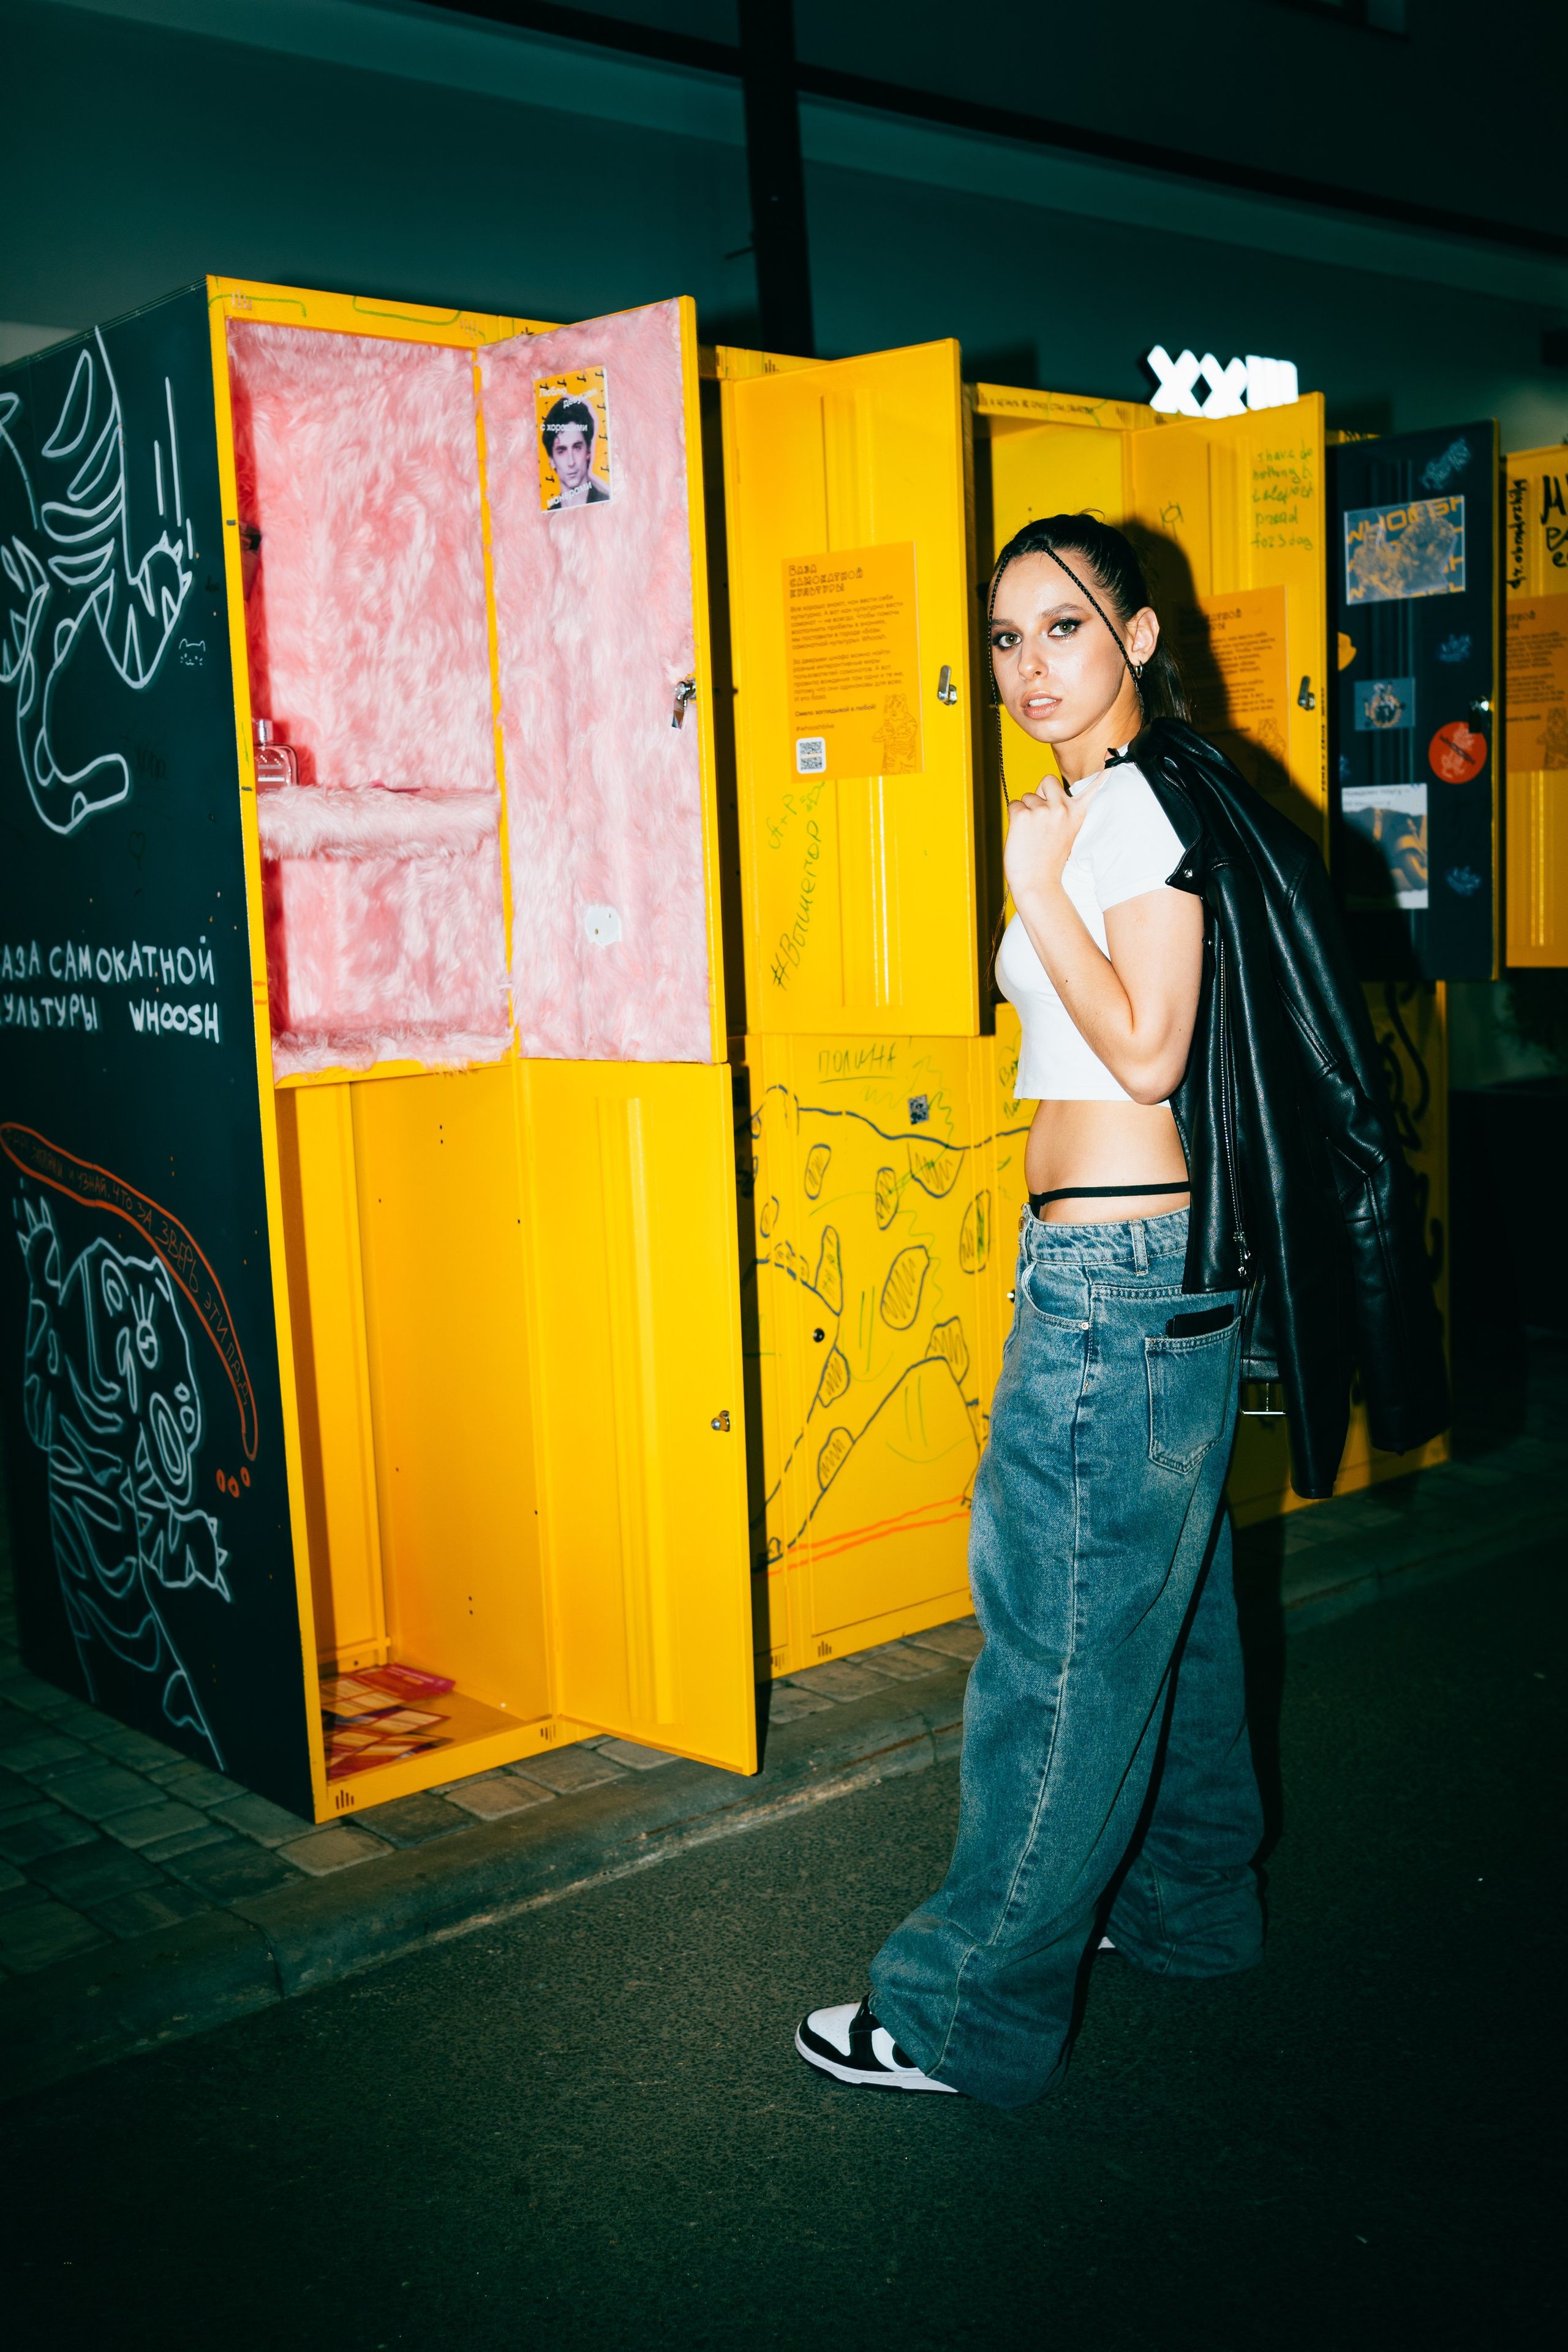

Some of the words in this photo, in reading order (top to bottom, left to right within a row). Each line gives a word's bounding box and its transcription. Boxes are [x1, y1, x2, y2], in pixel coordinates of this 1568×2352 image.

[539, 386, 568, 398] Люблю
[562, 387, 598, 409] девушек
[546, 421, 588, 434] хорошими
[546, 481, 593, 508] манерами
[791, 627, 826, 635] восполнить
[792, 639, 828, 650] самокатной
[816, 660, 862, 669] интерактивные
[793, 669, 838, 679] пользователей
[815, 706, 850, 715] заглядывай
[2, 939, 41, 980] АЗА
[49, 935, 215, 986] САМОКАТНОЙ
[1, 992, 98, 1031] УЛЬТУРЫ
[129, 998, 219, 1044] WHOOSH
[112, 1182, 133, 1211] ЧТО
[137, 1201, 153, 1231] ЗА
[155, 1220, 199, 1294] ЗВЕРЬ
[203, 1291, 228, 1344] ЭТИ
[225, 1341, 250, 1406] ПДД
